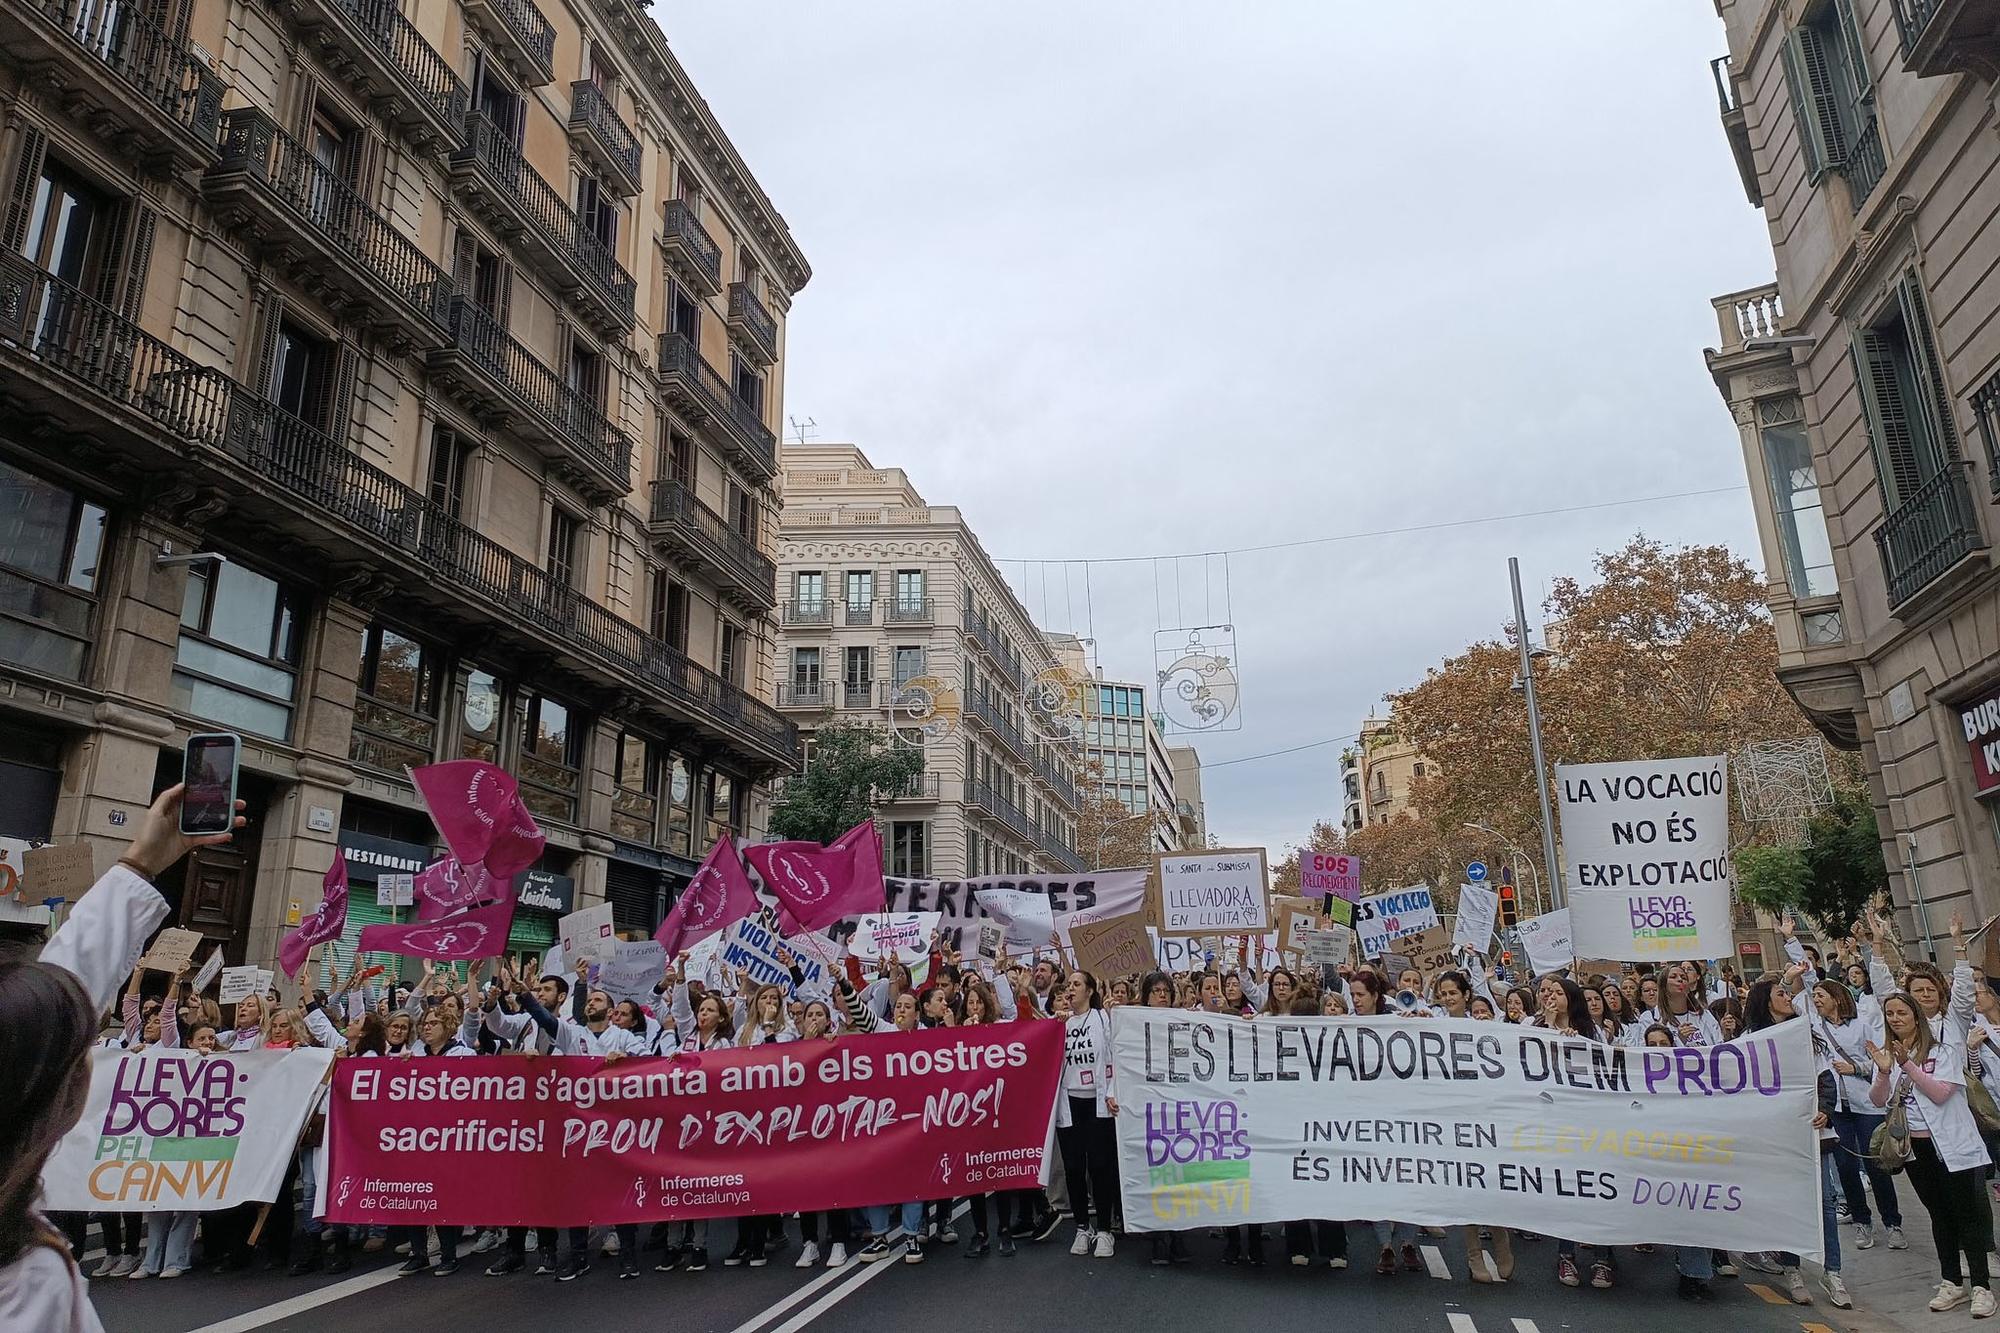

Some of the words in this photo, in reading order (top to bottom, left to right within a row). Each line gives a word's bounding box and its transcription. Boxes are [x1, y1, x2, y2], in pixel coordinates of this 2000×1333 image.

[1962, 694, 2000, 742] BUR
[1565, 779, 1597, 803] LA
[1602, 763, 1723, 802] VOCACIÓ
[1612, 820, 1657, 845] NO
[1666, 811, 1697, 843] ÉS
[344, 848, 423, 873] RESTAURANT
[1180, 863, 1201, 874] SANTA
[1313, 855, 1349, 875] SOS
[1578, 849, 1728, 887] EXPLOTACIÓ
[1171, 914, 1189, 926] EN
[1383, 917, 1400, 933] NO
[1631, 911, 1696, 930] DORES
[1080, 929, 1096, 948] LES
[1115, 939, 1142, 958] DIEM
[1065, 1039, 1092, 1051] LIKE
[1066, 1052, 1095, 1066] THIS
[1144, 1021, 1215, 1083] LES
[1227, 1023, 1505, 1082] LLEVADORES
[1519, 1036, 1631, 1092] DIEM
[1642, 1037, 1782, 1096] PROU
[351, 1069, 381, 1100] El
[388, 1069, 526, 1101] sistema
[721, 1055, 806, 1092] amb
[818, 1048, 872, 1083] els
[886, 1041, 1028, 1078] nostres
[101, 1096, 246, 1137] DORES
[379, 1119, 545, 1152] sacrificis!
[561, 1117, 664, 1158] PROU
[1302, 1119, 1444, 1146] INVERTIR
[1454, 1122, 1497, 1148] EN
[1512, 1120, 1736, 1165] LLEVADORES
[95, 1135, 149, 1161] PEL
[965, 1146, 1043, 1166] Infermeres
[1145, 1129, 1251, 1167] DORES
[88, 1159, 233, 1201] CANVI
[364, 1178, 433, 1193] Infermeres
[660, 1173, 744, 1190] Infermeres
[966, 1168, 983, 1183] de
[1292, 1149, 1330, 1182] ÉS
[1342, 1157, 1487, 1189] INVERTIR
[1499, 1163, 1543, 1194] EN
[1554, 1168, 1618, 1201] LES
[1632, 1177, 1742, 1211] DONES
[359, 1195, 376, 1210] de
[379, 1195, 438, 1213] Catalunya
[660, 1192, 679, 1207] de
[682, 1188, 750, 1207] Catalunya
